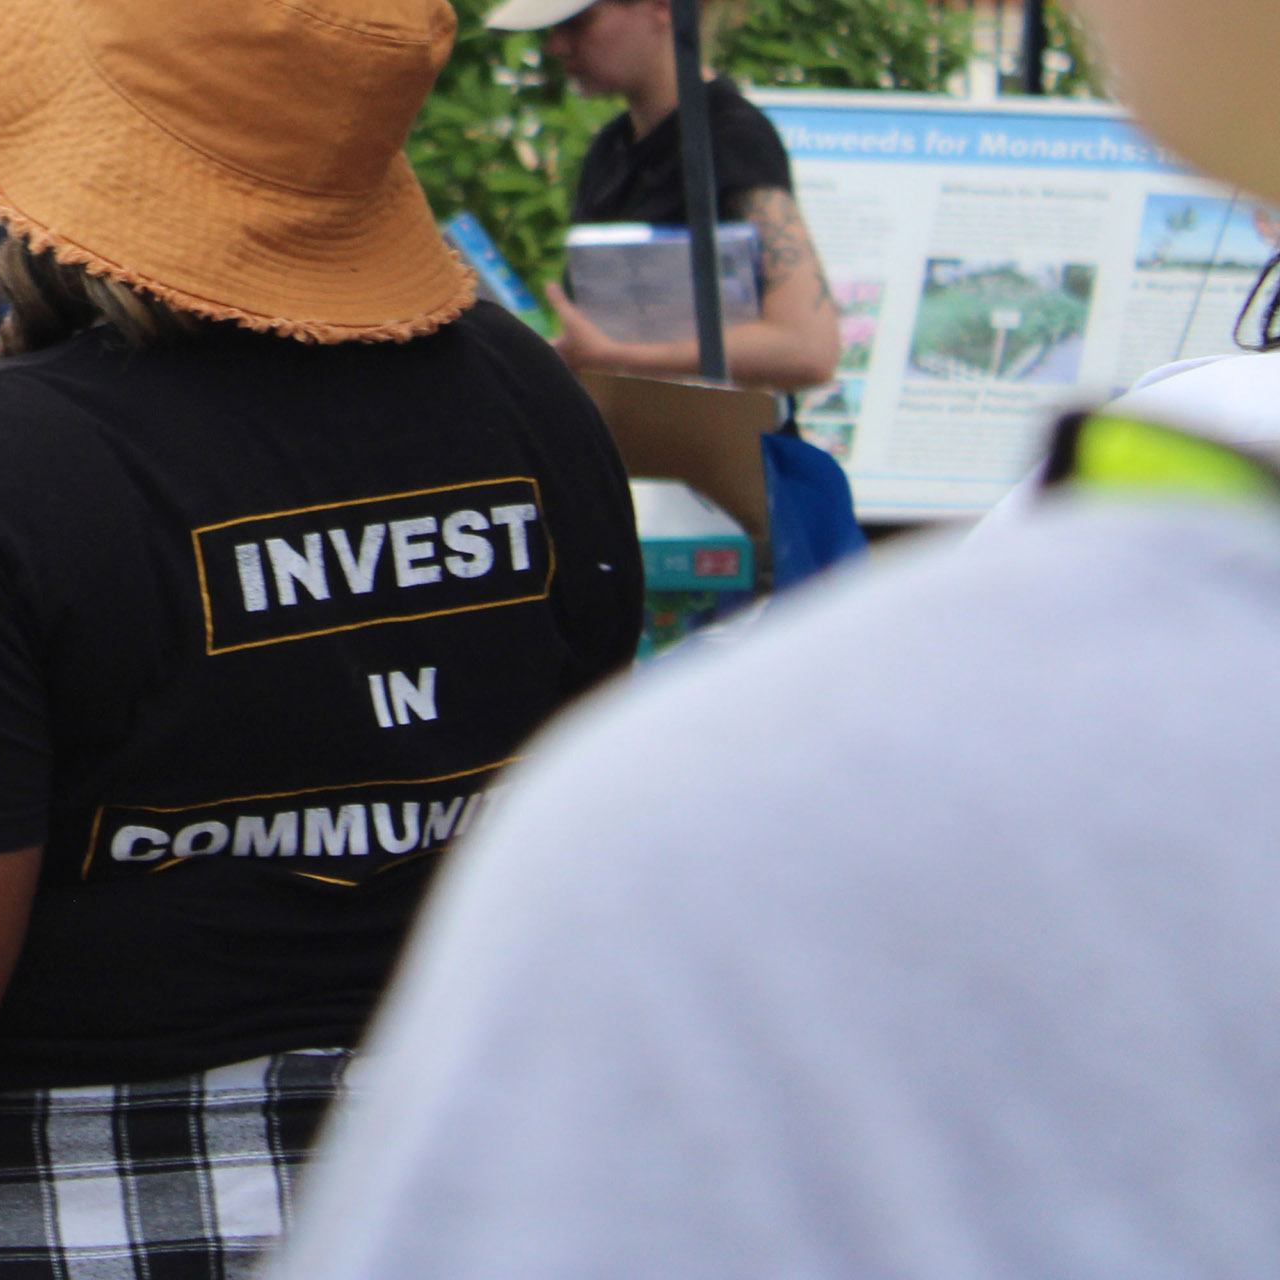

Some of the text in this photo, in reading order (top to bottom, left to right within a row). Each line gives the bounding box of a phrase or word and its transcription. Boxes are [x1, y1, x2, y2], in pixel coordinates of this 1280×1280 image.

[925, 129, 969, 156] for
[234, 503, 537, 612] INVEST
[368, 666, 438, 728] IN
